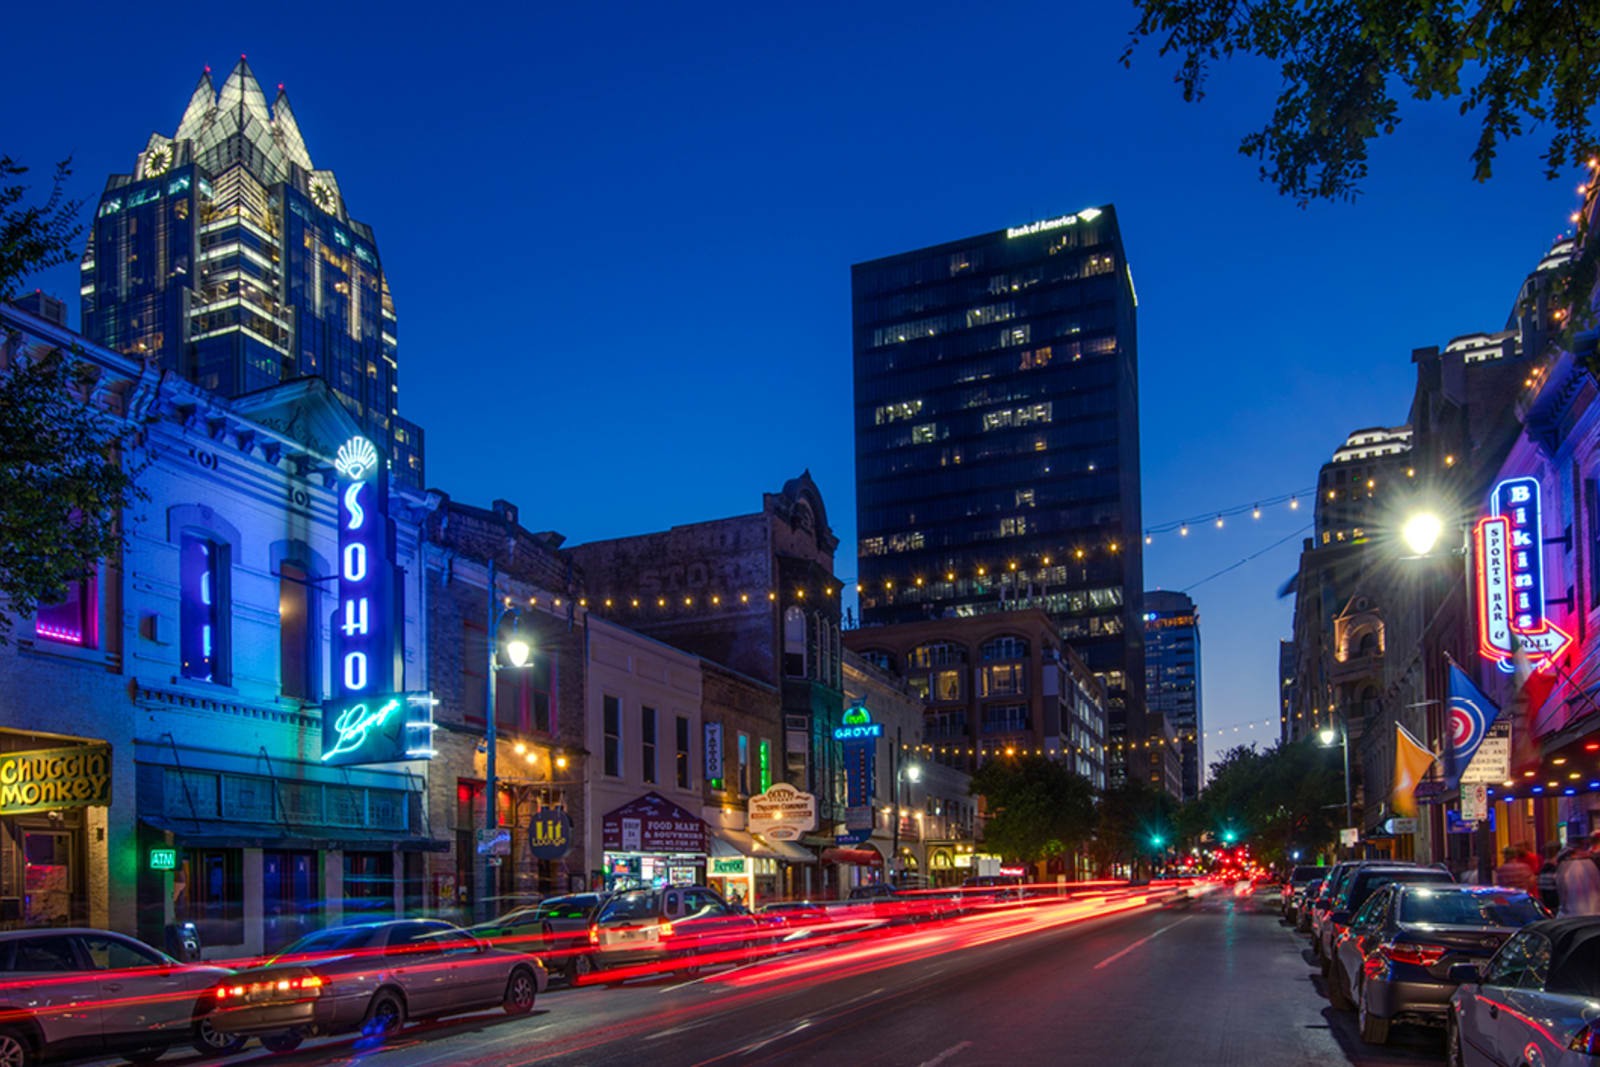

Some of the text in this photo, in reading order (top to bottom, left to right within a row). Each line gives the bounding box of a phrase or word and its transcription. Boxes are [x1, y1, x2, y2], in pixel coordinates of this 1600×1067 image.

[1007, 216, 1076, 238] Bank of America
[1490, 528, 1501, 585] SPORTS
[1509, 485, 1534, 629] Bikinis
[341, 480, 369, 691] SOHO
[1492, 593, 1503, 621] BAR
[1520, 638, 1552, 649] RILL
[835, 726, 879, 738] GROVE
[708, 729, 718, 772] TATTOO
[1, 775, 107, 806] Monkey
[535, 820, 562, 840] Lit
[647, 821, 673, 831] FOOD
[674, 821, 700, 832] MART
[152, 852, 174, 866] ATM
[714, 859, 744, 872] TATTOO
